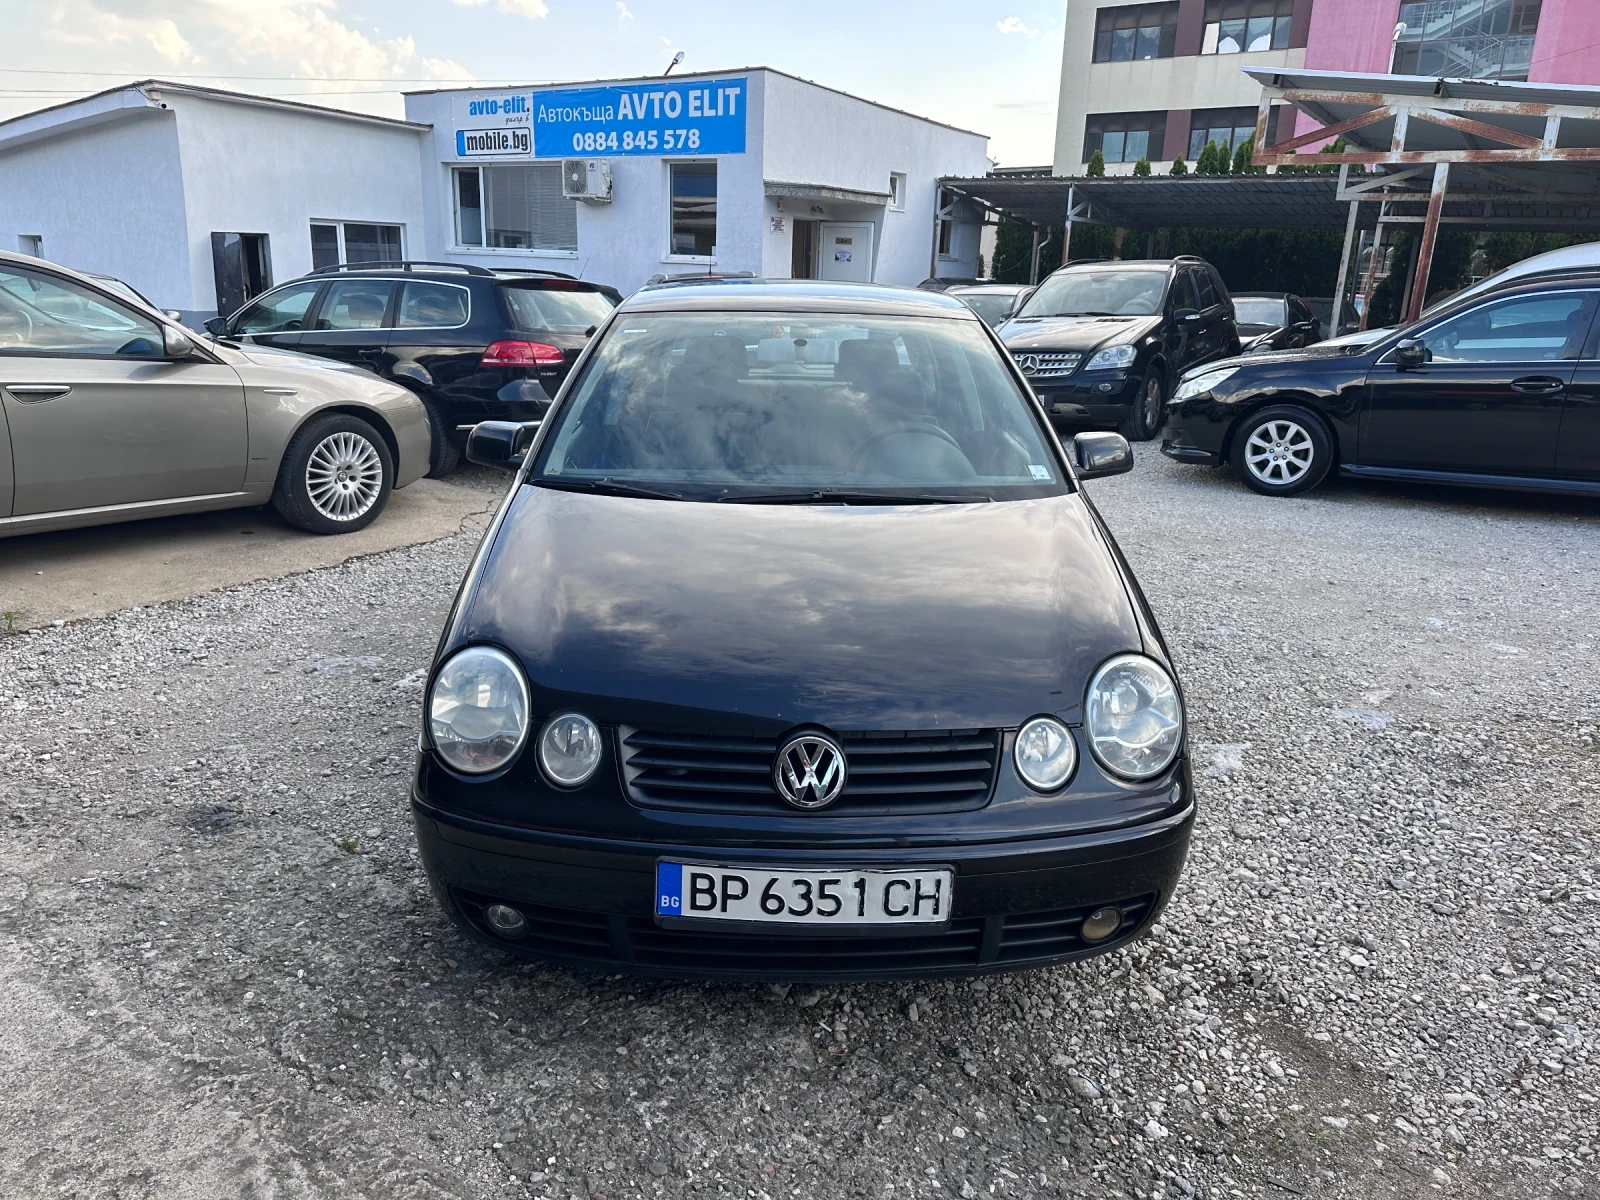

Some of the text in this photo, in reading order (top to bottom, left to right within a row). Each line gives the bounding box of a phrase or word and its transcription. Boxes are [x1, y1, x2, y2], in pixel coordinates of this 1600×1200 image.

[537, 87, 741, 125] Автокъща AVTO ELIT
[466, 130, 529, 151] mobile.bg
[572, 128, 700, 152] 0884 845 578
[661, 895, 680, 908] BG
[760, 877, 868, 917] 6351
